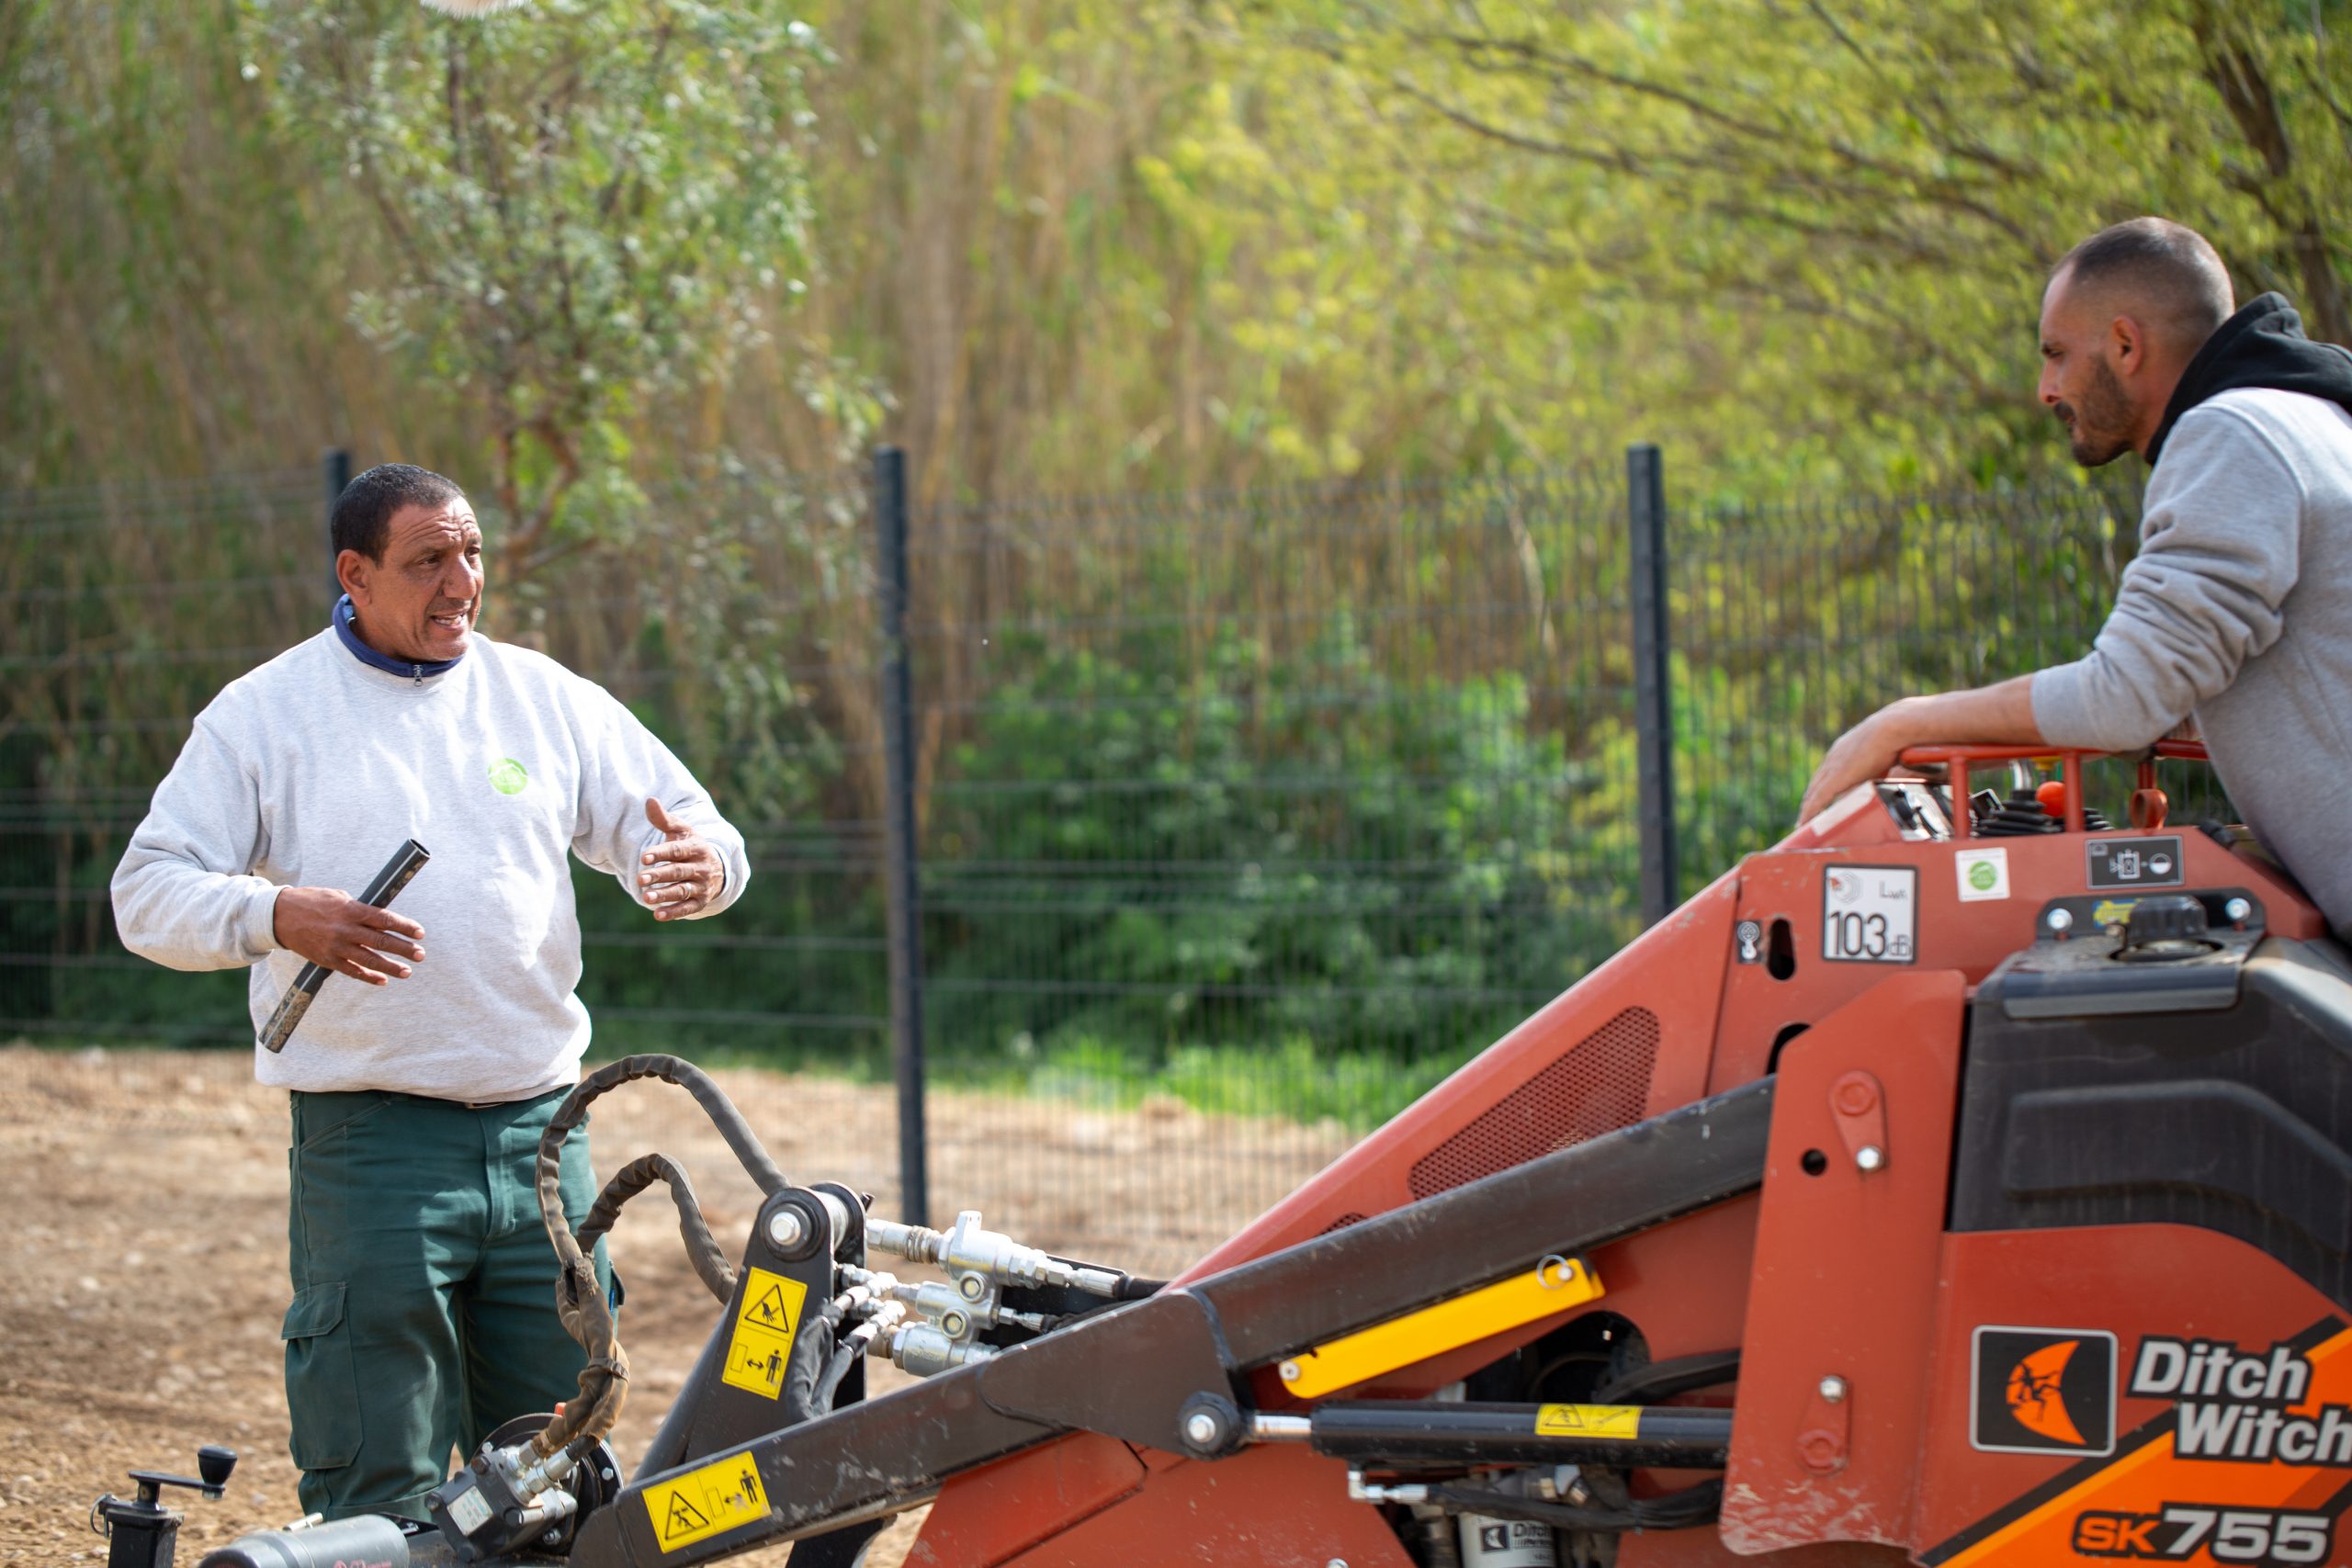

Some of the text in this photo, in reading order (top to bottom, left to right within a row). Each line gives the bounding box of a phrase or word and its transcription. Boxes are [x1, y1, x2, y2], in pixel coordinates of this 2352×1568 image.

[1829, 911, 1912, 957] 103 dB
[2132, 1340, 2309, 1401] Ditch
[2177, 1402, 2352, 1463] Witch
